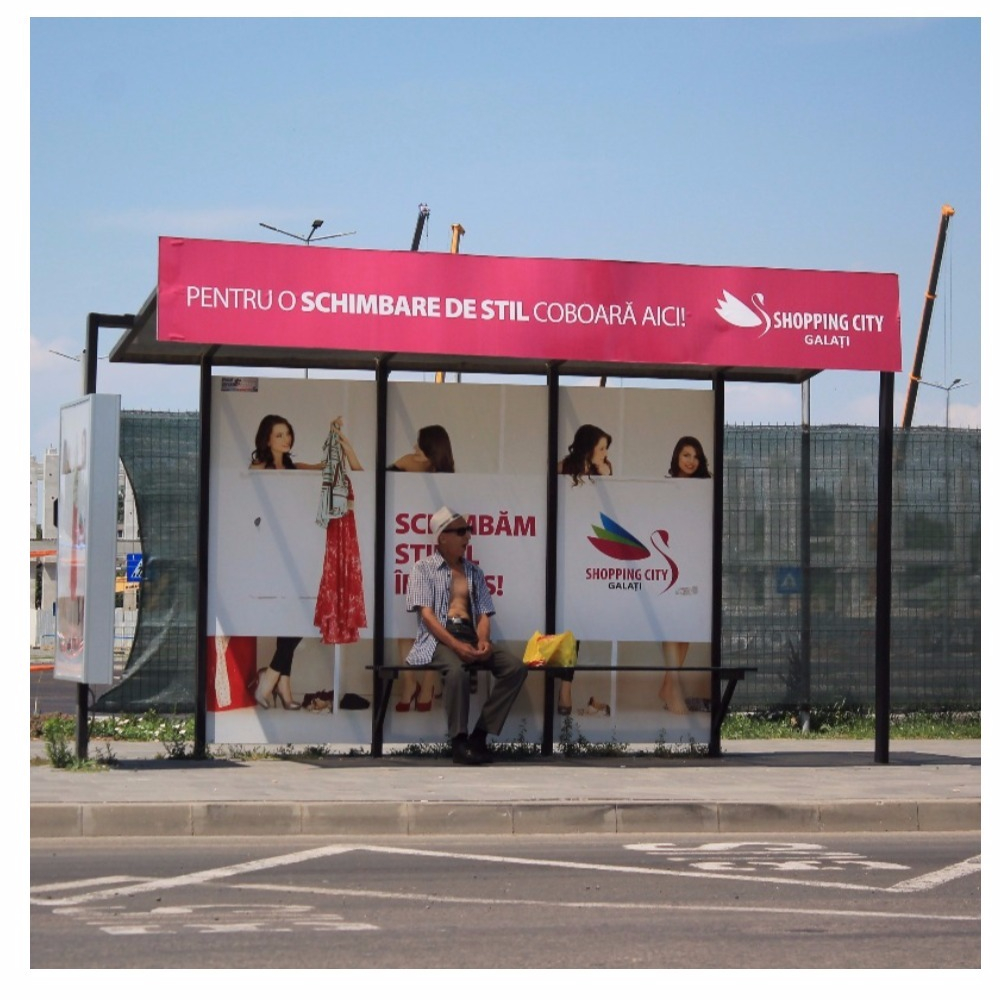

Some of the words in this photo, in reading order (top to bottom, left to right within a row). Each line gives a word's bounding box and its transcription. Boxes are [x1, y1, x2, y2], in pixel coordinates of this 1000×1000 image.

[187, 286, 272, 310] PENTRU
[278, 290, 296, 311] O
[301, 291, 441, 317] SCHIMBARE
[445, 298, 477, 319] DE
[481, 299, 530, 321] STIL
[533, 301, 637, 326] COBOARĂ
[641, 306, 686, 327] AICI!
[773, 311, 849, 331] SHOPPING
[852, 314, 884, 332] CITY
[585, 568, 642, 581] SHOPPING
[644, 569, 668, 581] CITY
